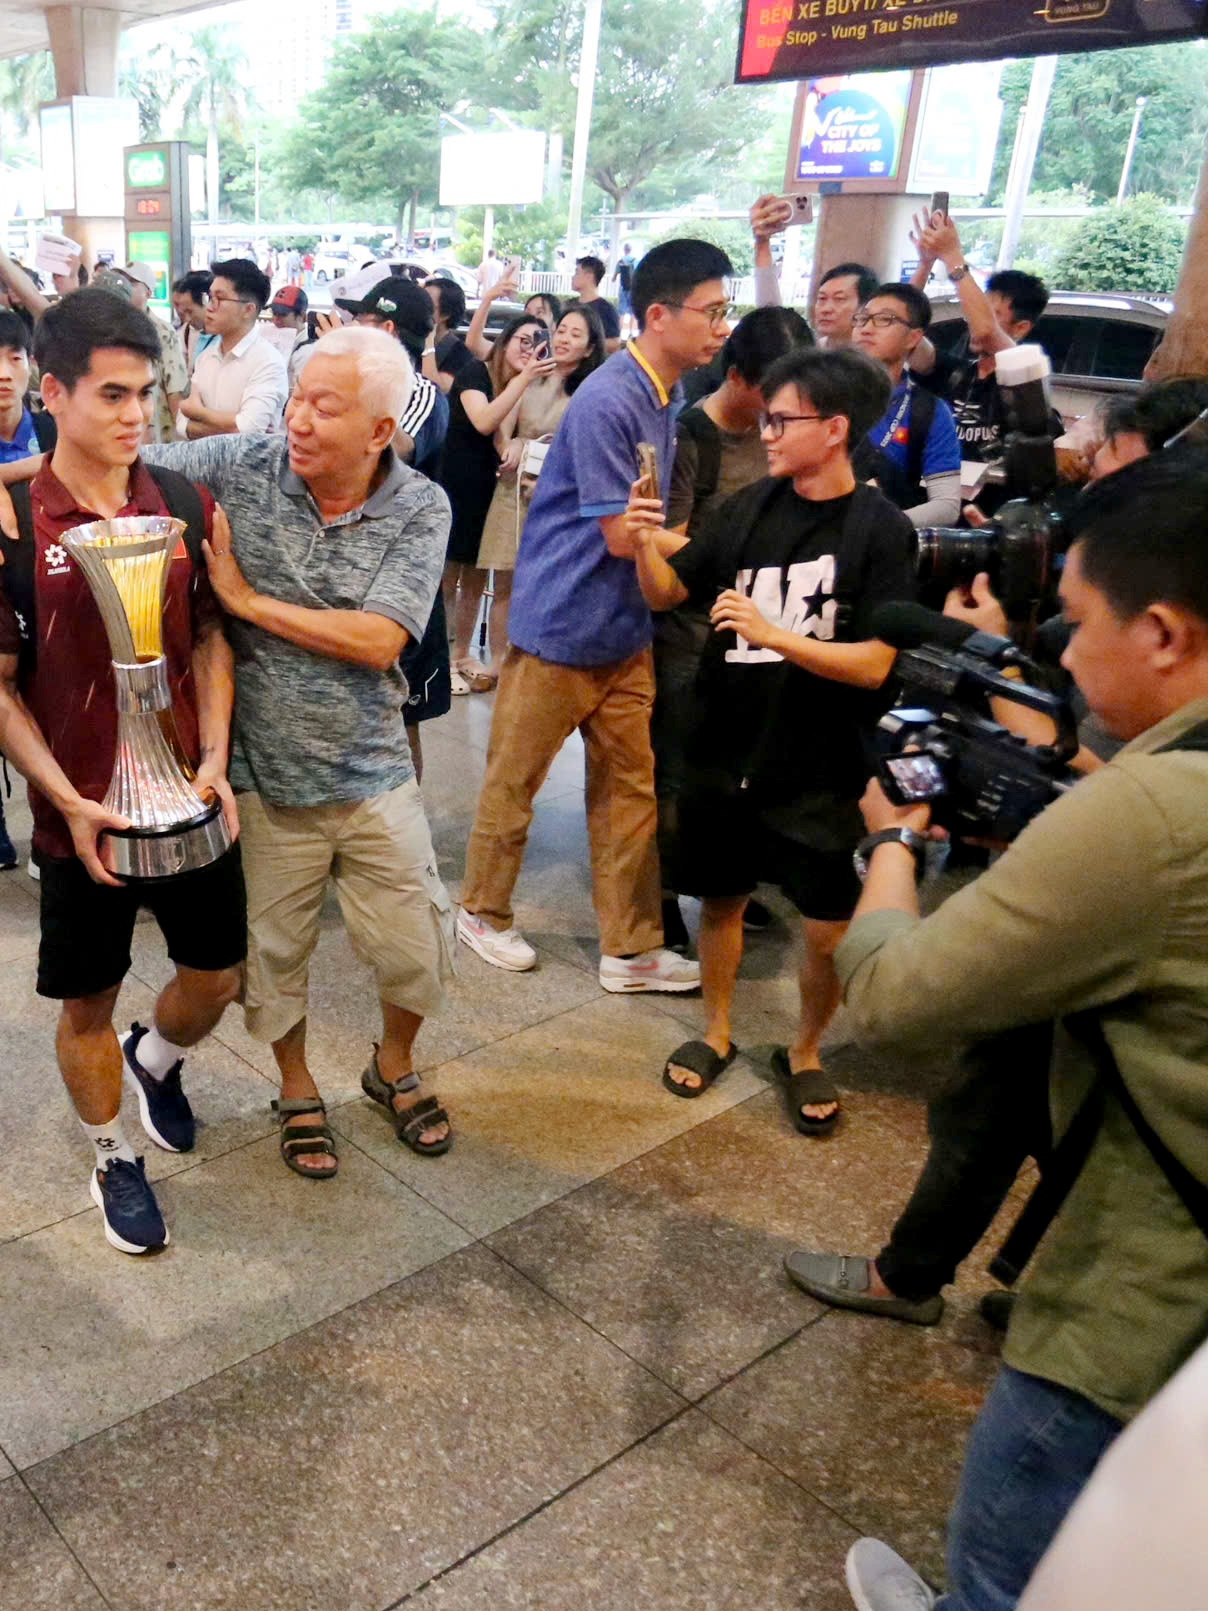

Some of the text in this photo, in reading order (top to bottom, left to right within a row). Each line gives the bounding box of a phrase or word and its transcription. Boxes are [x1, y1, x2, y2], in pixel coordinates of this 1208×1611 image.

[798, 1, 821, 20] XE
[786, 30, 817, 46] Stop
[831, 24, 867, 40] Vung
[872, 19, 898, 34] Tau
[902, 11, 958, 31] Shuttle
[827, 123, 880, 139] CITY OF
[821, 140, 847, 154] THE
